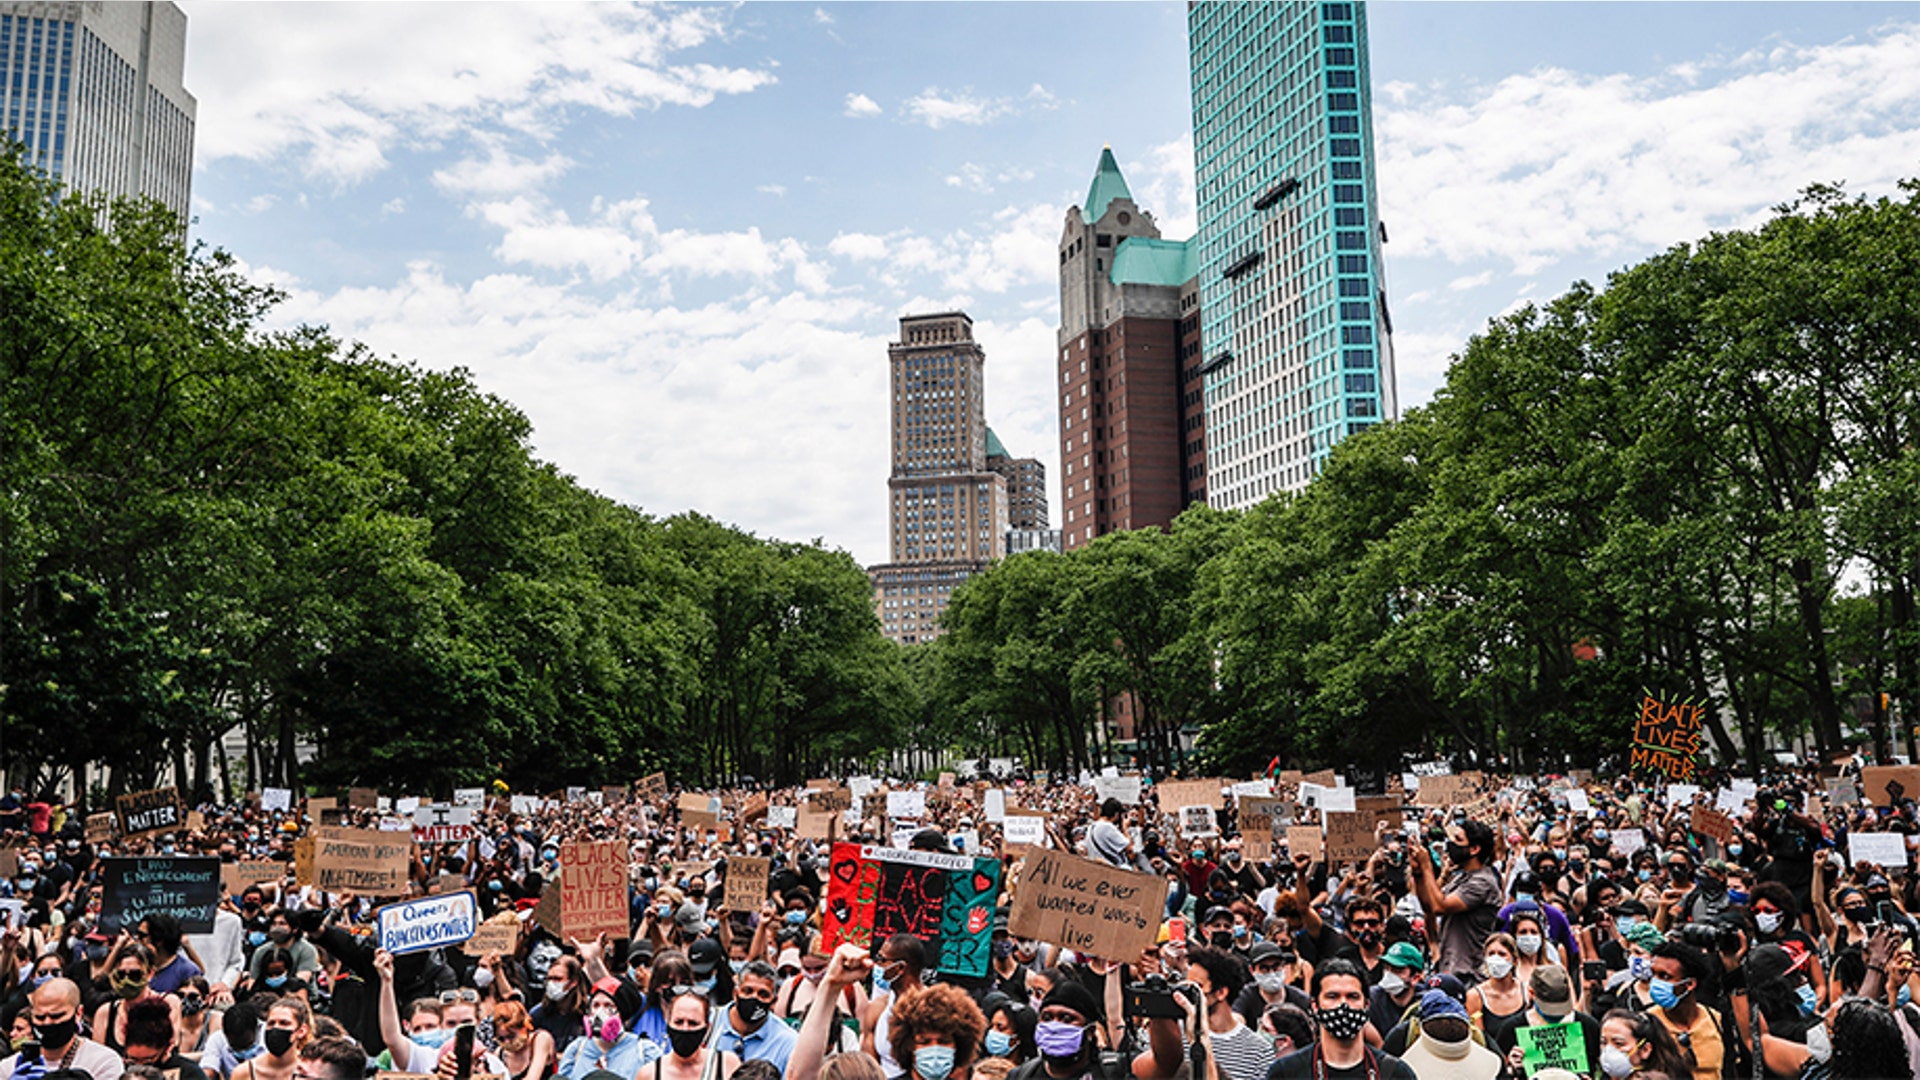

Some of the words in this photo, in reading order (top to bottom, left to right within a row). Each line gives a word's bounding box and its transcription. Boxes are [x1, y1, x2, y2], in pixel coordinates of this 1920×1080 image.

[1642, 696, 1705, 730] BLACK
[1634, 720, 1702, 754] LIVES
[1630, 748, 1696, 780] MATTER
[128, 806, 176, 831] MATTER
[432, 809, 450, 825] I
[415, 825, 471, 841] MATTER
[560, 840, 626, 867] BLACK
[562, 863, 623, 890] LIVES
[857, 861, 968, 905] BLACK
[1028, 856, 1060, 884] All
[1062, 874, 1087, 892] we
[1096, 880, 1141, 899] ever
[403, 904, 448, 921] Queers
[562, 887, 626, 911] MATTER
[1036, 893, 1098, 916] wanted
[1060, 918, 1095, 948] live
